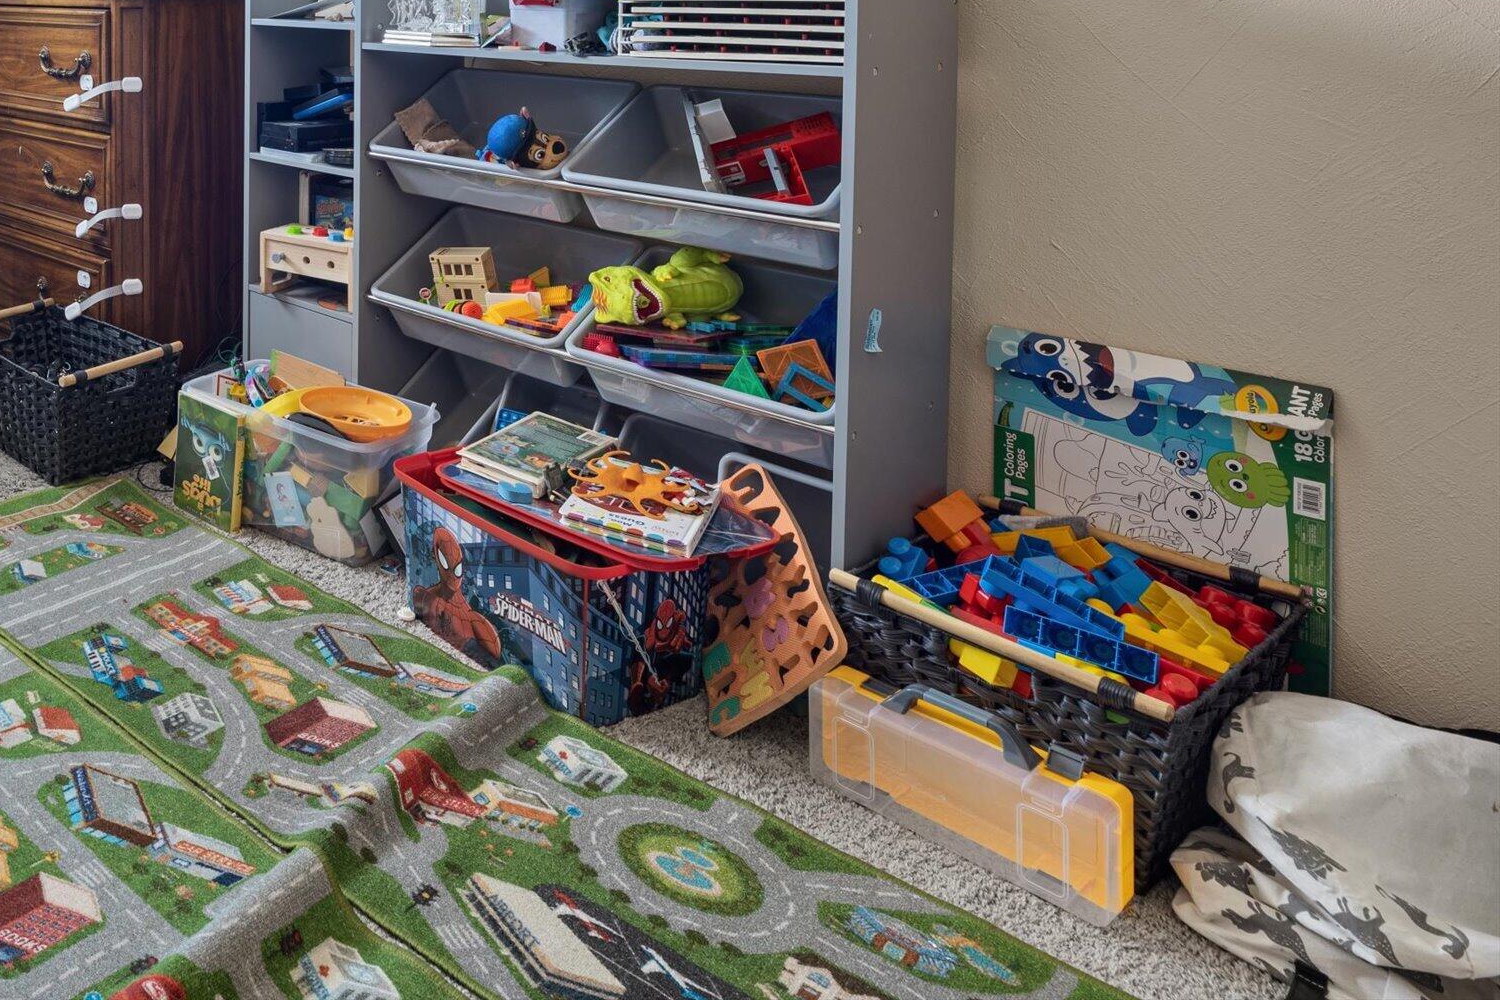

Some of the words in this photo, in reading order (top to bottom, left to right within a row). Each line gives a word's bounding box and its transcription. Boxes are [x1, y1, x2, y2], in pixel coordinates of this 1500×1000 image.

[1003, 431, 1017, 477] Coloring
[1015, 448, 1029, 480] Pages
[1293, 442, 1313, 462] 18
[492, 596, 568, 657] SPIDER-MAN
[487, 893, 542, 950] AIRPORT
